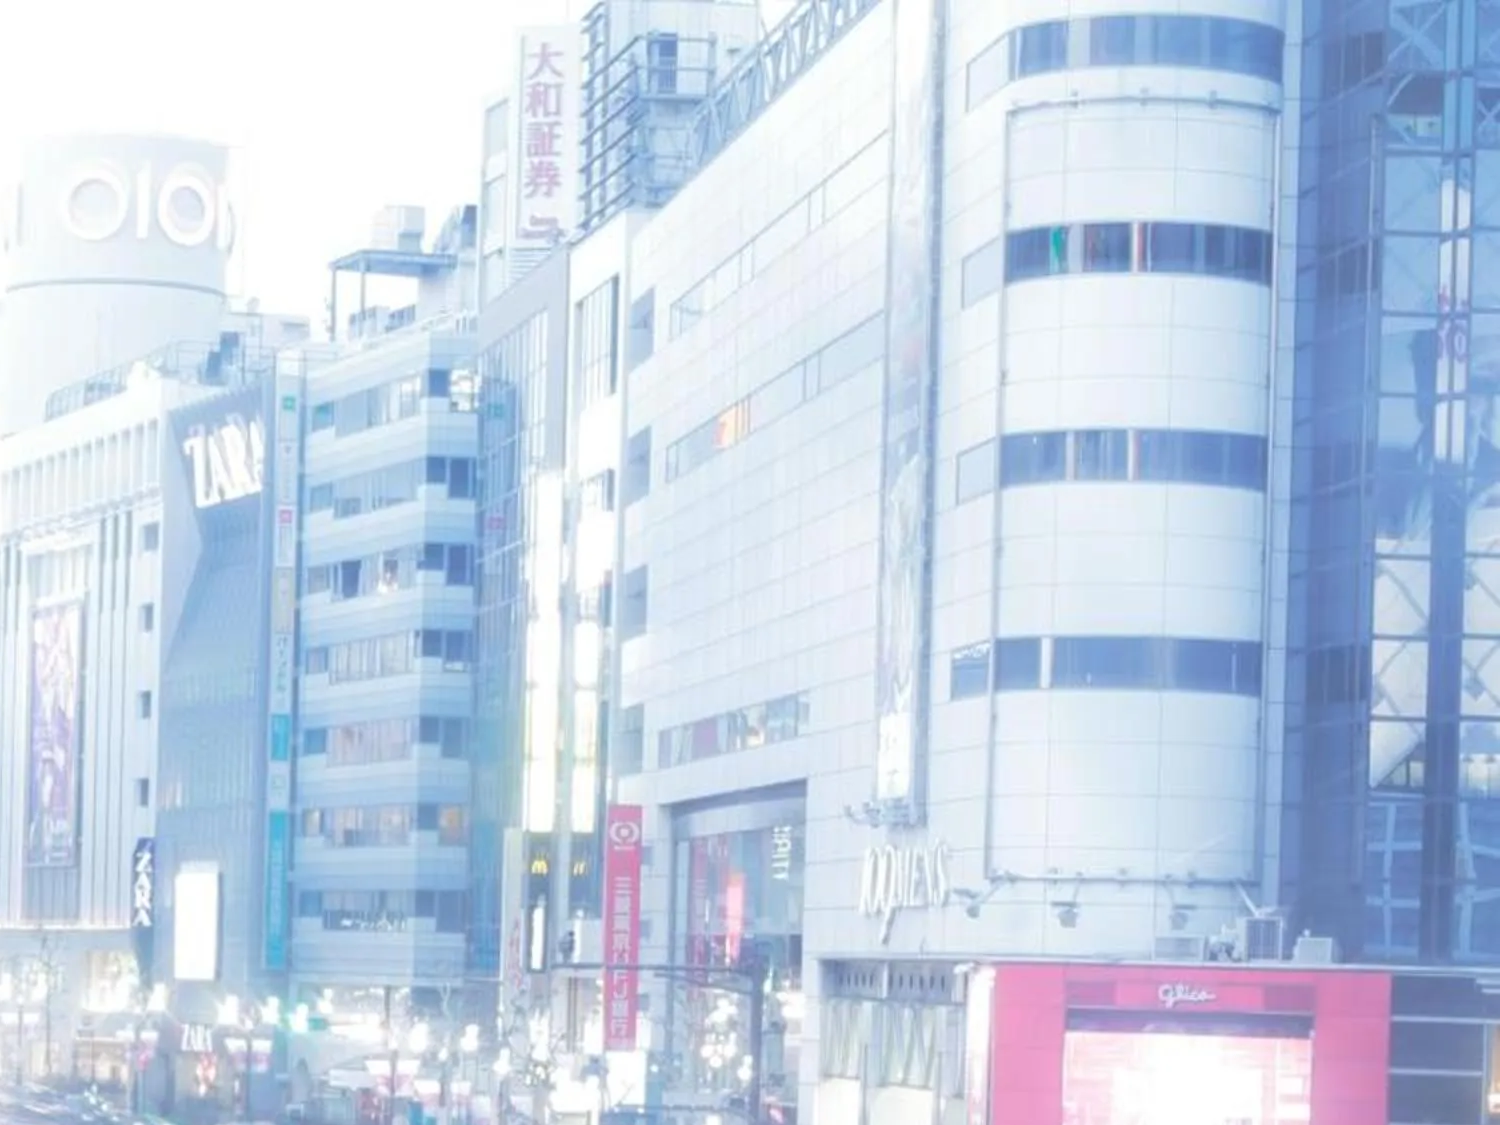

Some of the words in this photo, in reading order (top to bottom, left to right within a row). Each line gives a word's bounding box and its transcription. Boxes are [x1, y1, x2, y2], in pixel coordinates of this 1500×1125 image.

[524, 42, 565, 199] 大和証券
[133, 851, 154, 926] ZARA
